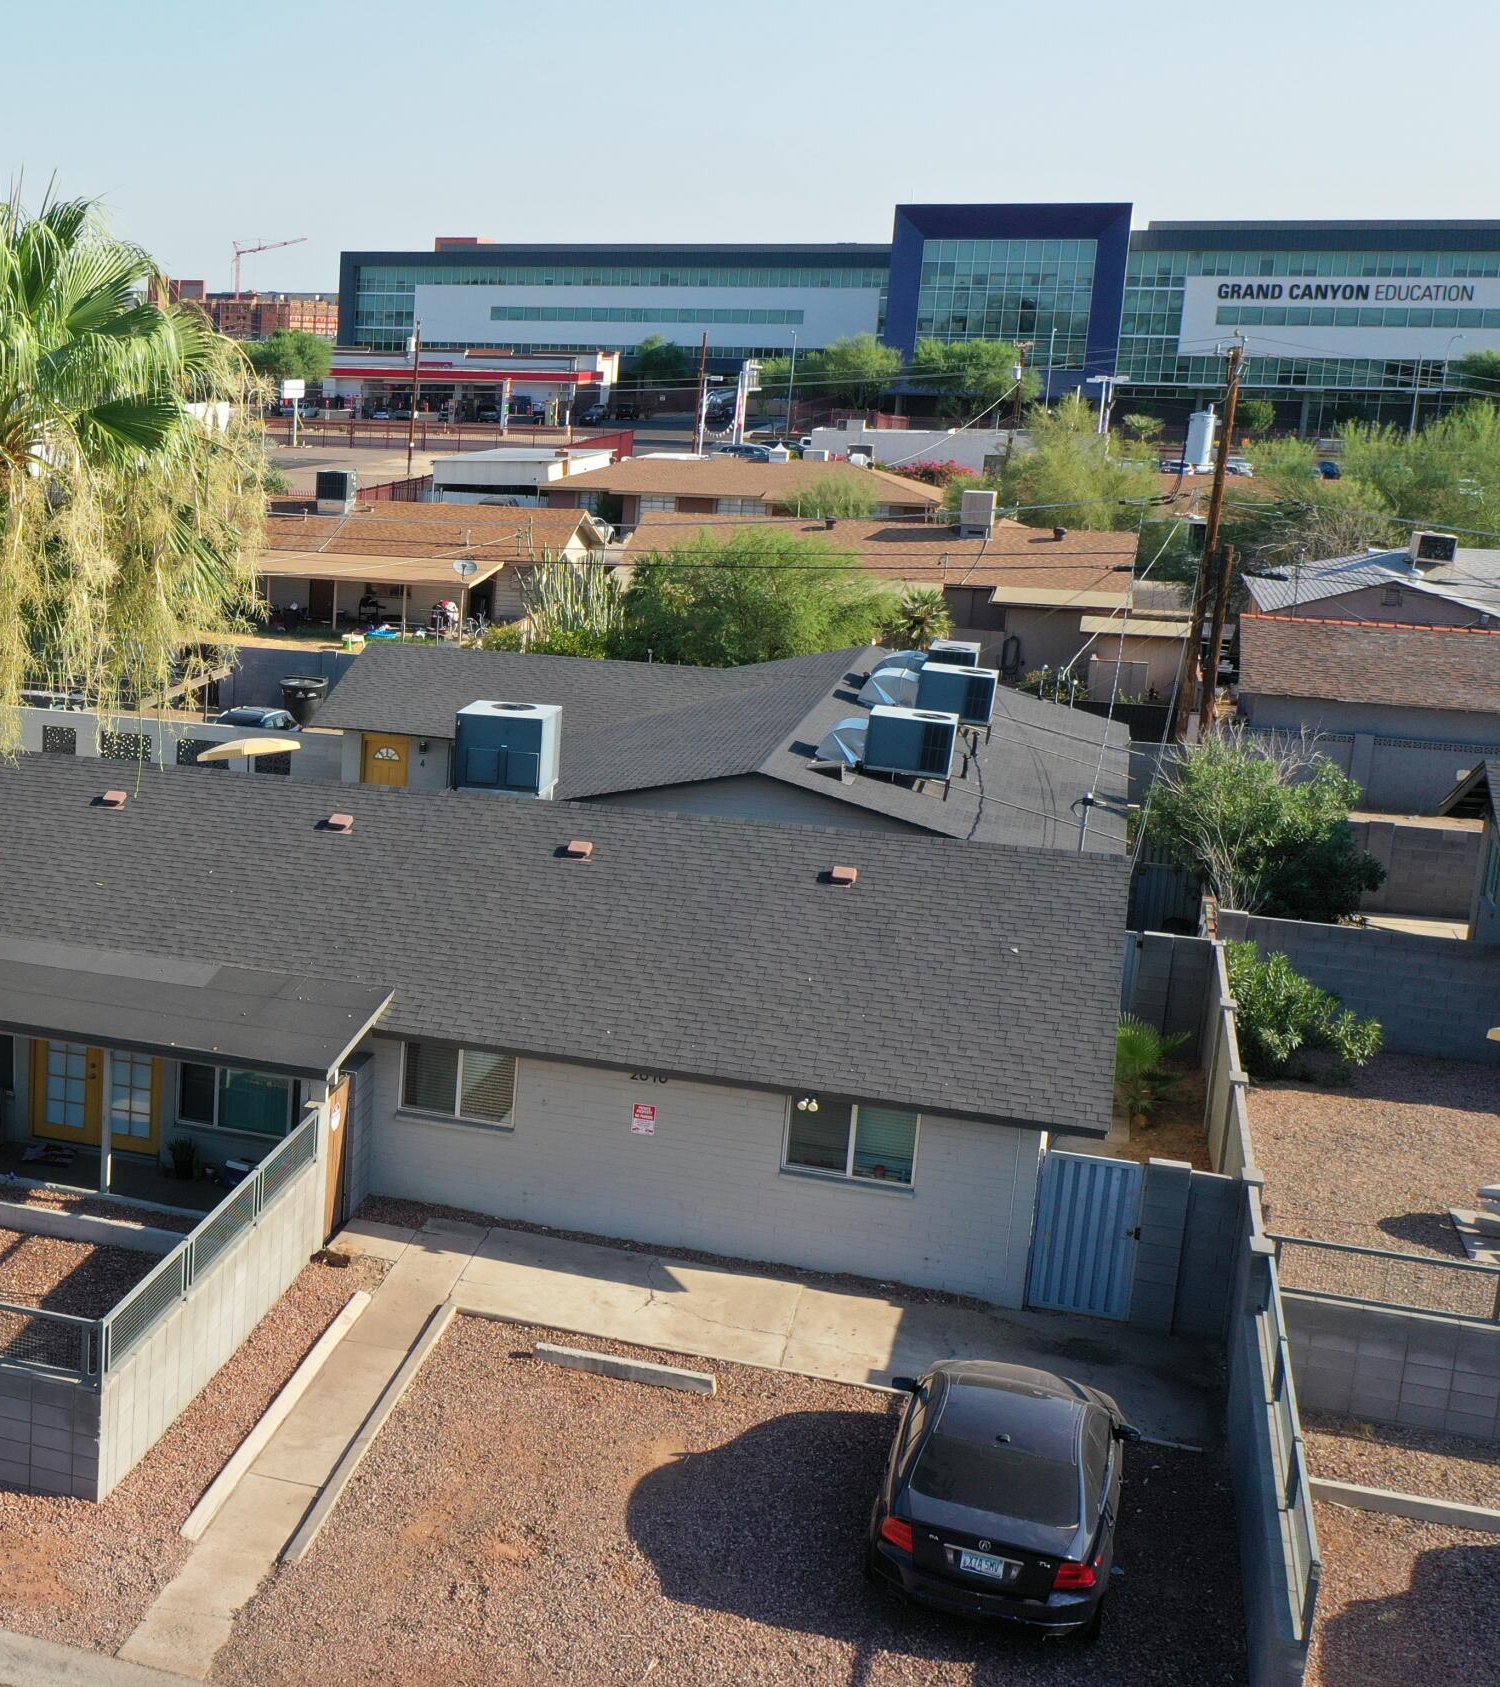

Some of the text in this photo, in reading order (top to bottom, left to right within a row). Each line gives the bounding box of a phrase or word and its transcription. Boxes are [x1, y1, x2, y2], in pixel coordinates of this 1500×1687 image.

[1217, 283, 1474, 301] GRAND CANYON EDUCATION
